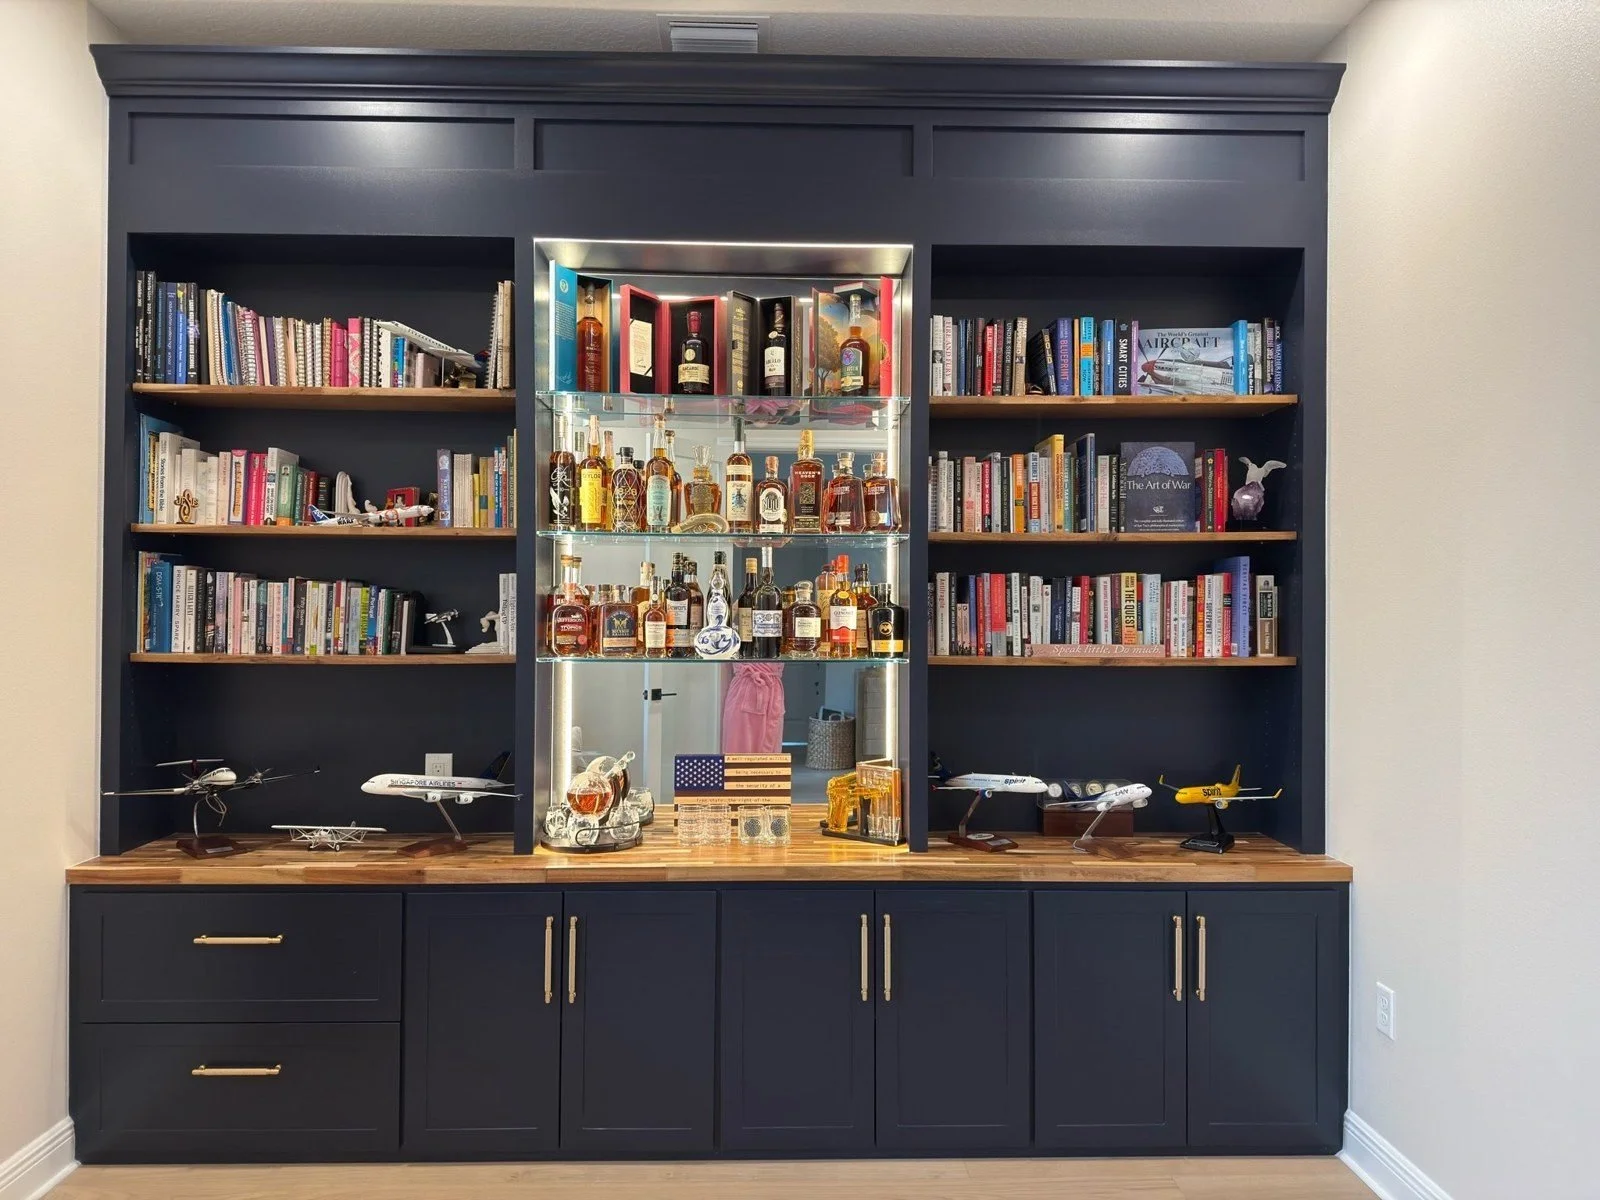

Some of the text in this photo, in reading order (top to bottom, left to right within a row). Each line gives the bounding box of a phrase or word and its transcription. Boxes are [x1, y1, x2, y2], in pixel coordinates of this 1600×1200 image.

[1060, 340, 1068, 380] BLUEPRINT
[1119, 339, 1128, 388] SMART CITIES
[1127, 480, 1191, 490] The Art of War
[1124, 590, 1135, 628] THE QUEST
[1052, 645, 1161, 655] Speak little. Do much.
[1202, 787, 1222, 798] spirit
